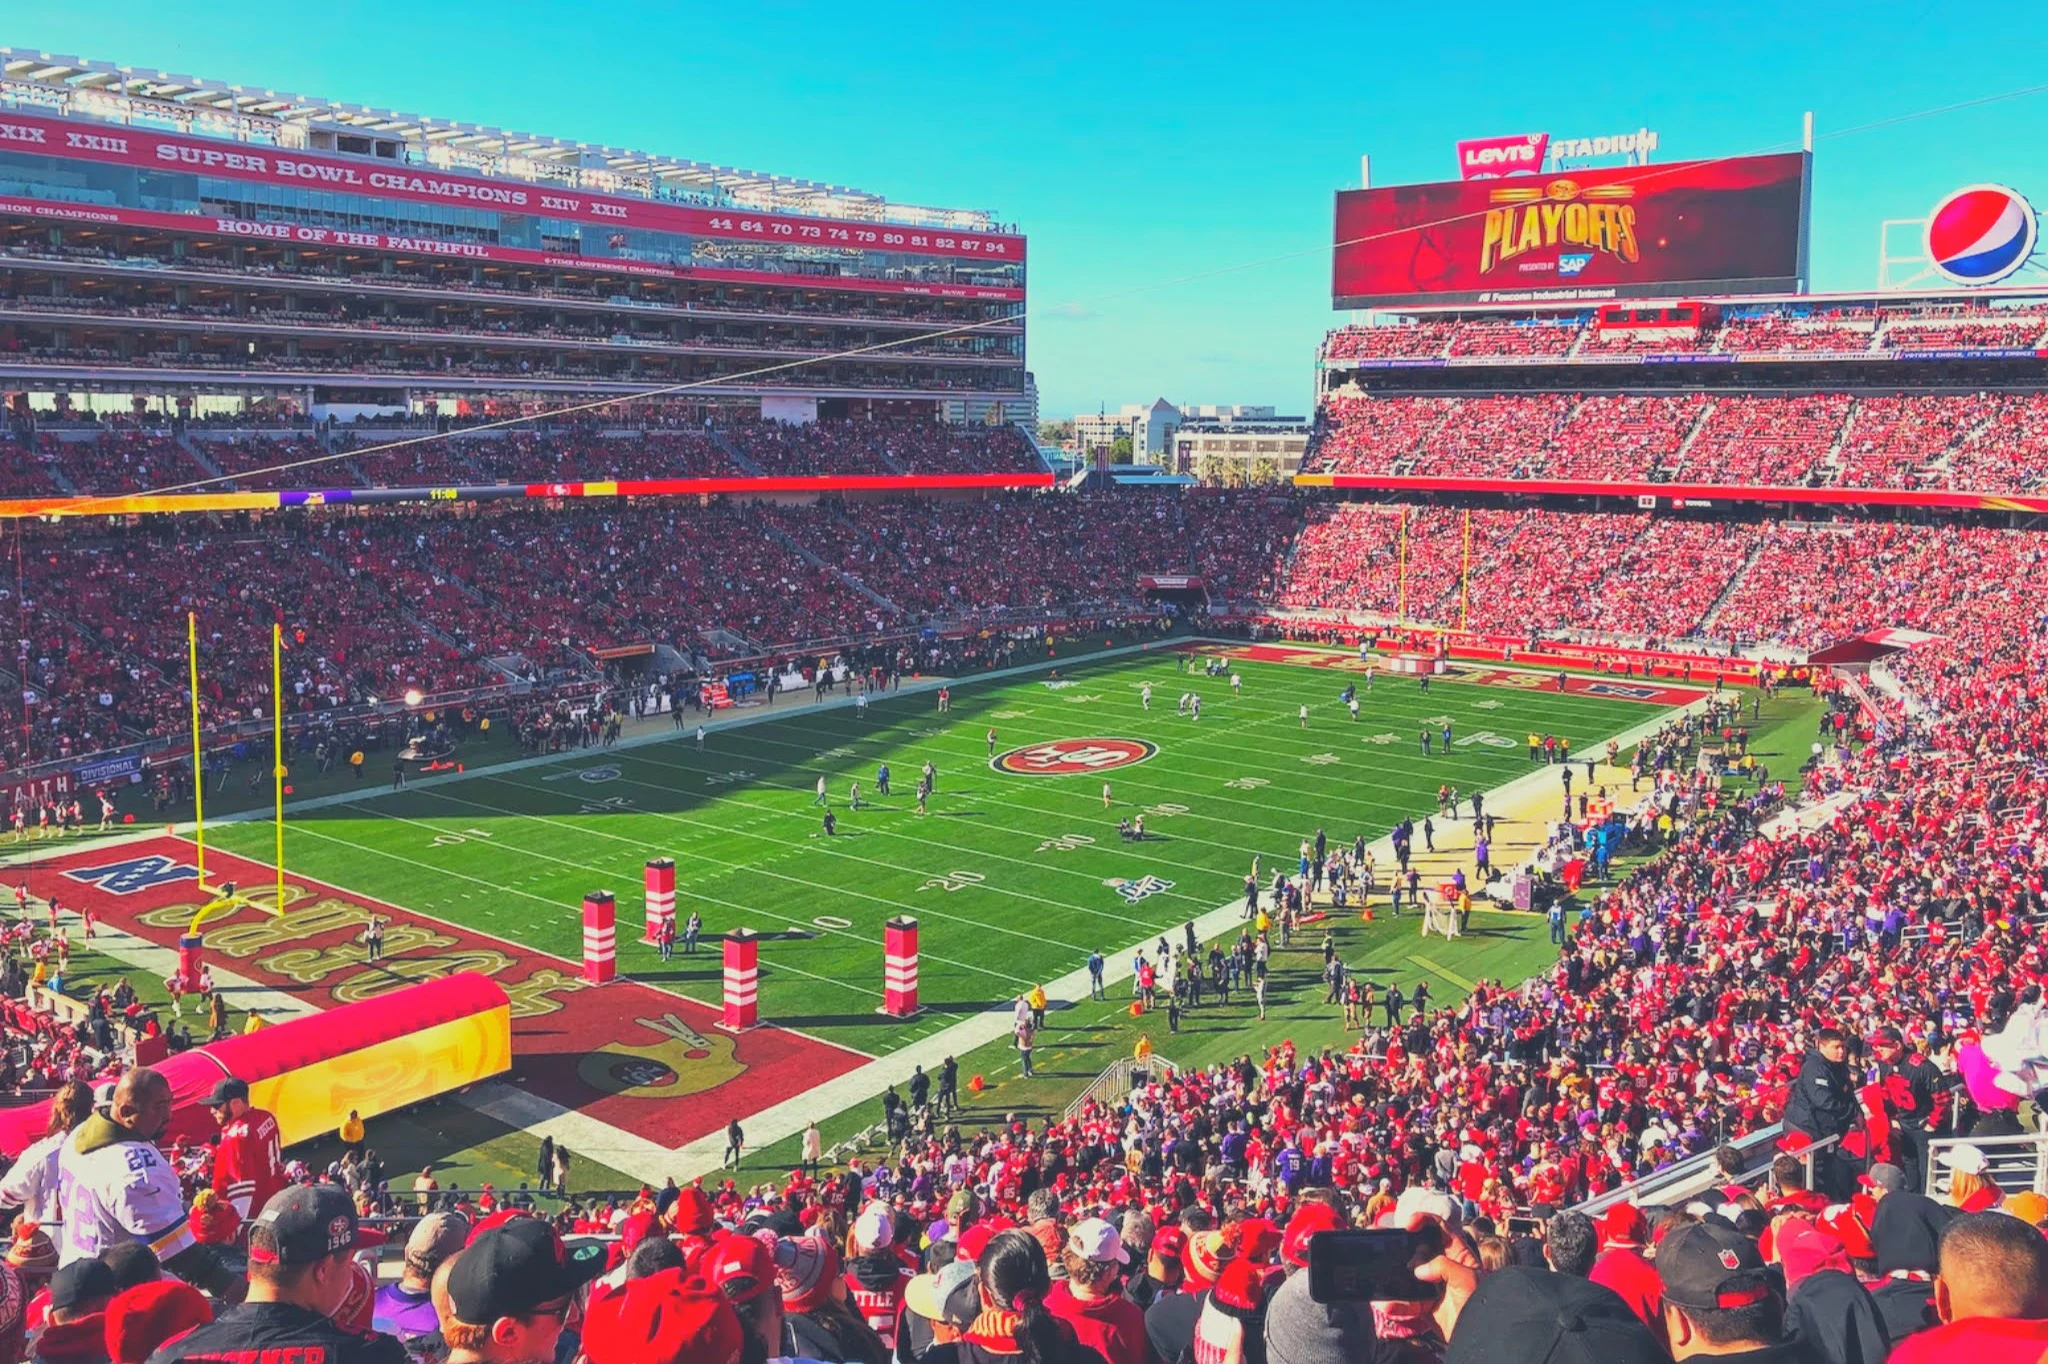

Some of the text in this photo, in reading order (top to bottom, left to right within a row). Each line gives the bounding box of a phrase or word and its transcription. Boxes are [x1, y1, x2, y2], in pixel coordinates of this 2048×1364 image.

[1551, 131, 1658, 158] STADIUM
[0, 123, 627, 218] XIX XXIII SUPER BOWL CHAMPIONS XXIV XXIX
[36, 206, 119, 222] CHAMPIONS
[217, 219, 290, 238] HOME
[297, 228, 327, 241] OF
[333, 231, 379, 247] THE
[387, 235, 488, 258] FAITHFUL
[709, 217, 1005, 253] 44 64 70 73 74 79 80 81 82 87 94
[1480, 202, 1639, 275] PLAYOFFS
[1559, 258, 1586, 273] SAP
[1493, 292, 1533, 302] Foxconn
[1533, 290, 1577, 300] Industrial
[1578, 288, 1616, 298] Internet
[1684, 499, 1712, 508] TOYOTA
[81, 760, 135, 780] DIVISIONAL
[1041, 833, 1096, 852] 30
[926, 870, 985, 892] 20
[124, 1147, 157, 1170] 22
[328, 1230, 351, 1251] 1946
